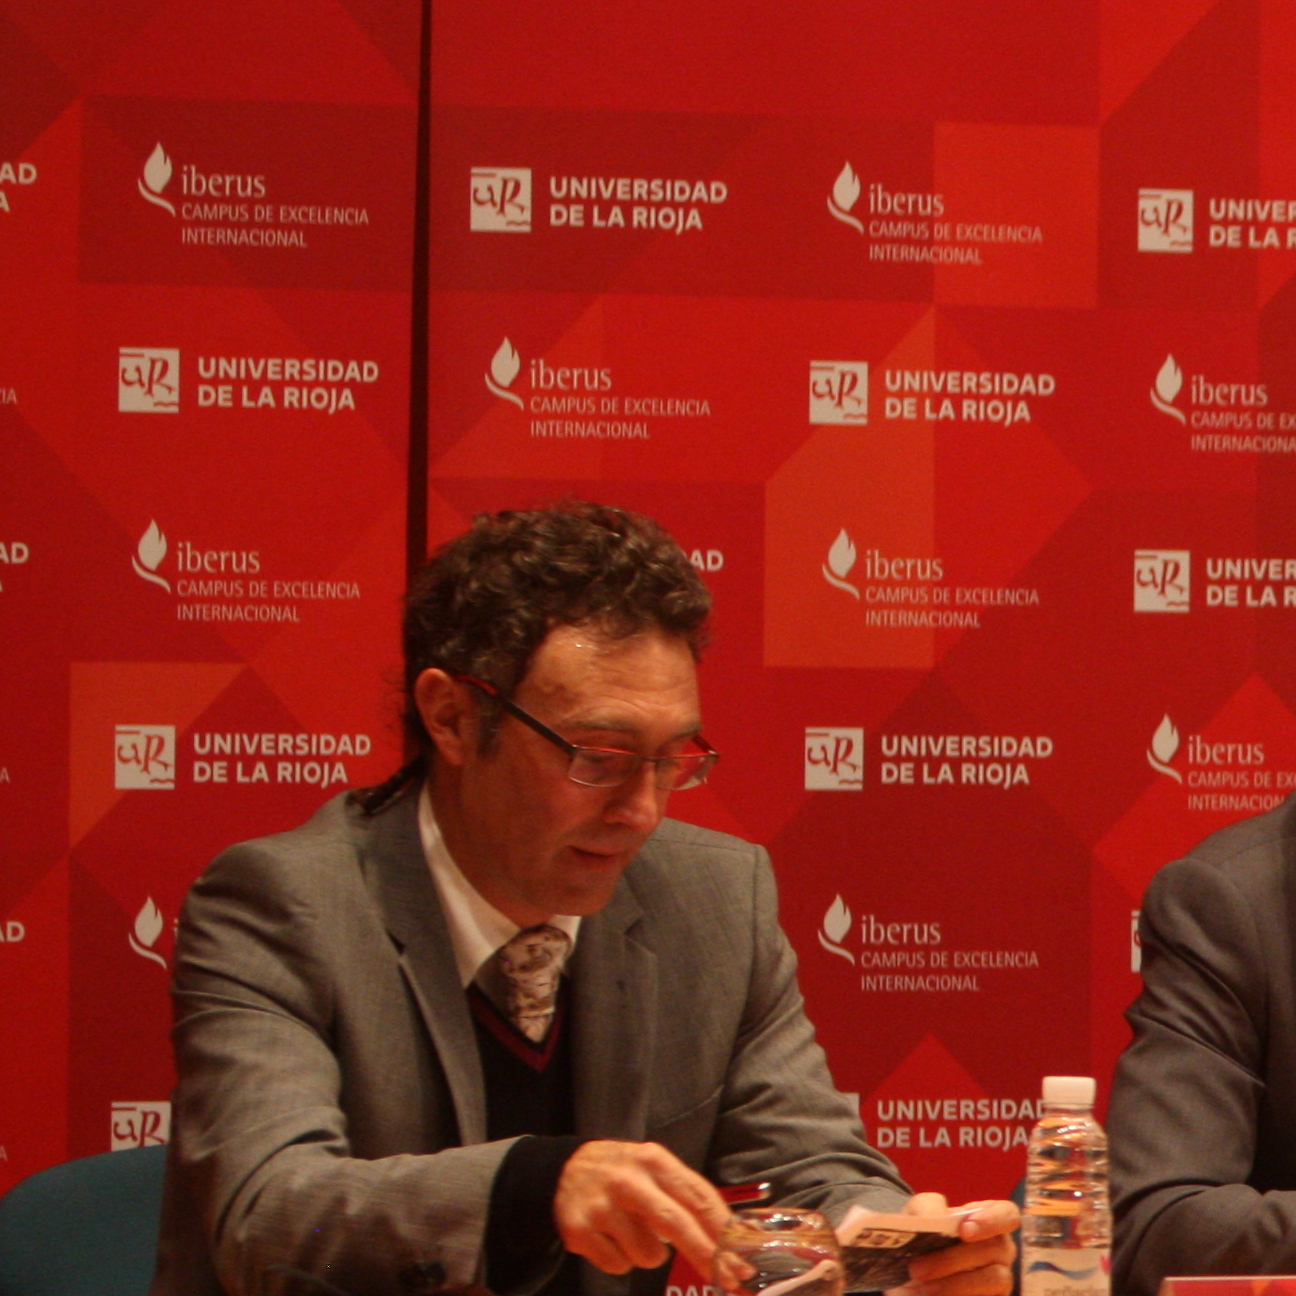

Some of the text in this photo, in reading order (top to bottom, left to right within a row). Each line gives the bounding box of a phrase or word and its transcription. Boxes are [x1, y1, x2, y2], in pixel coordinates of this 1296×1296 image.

[182, 165, 266, 197] iberus
[550, 177, 727, 203] UNIVERSIDAD
[869, 184, 944, 216] iberus
[182, 204, 369, 225] CAMPUS DE EXCELENCIA
[550, 204, 702, 234] DE LA RIOJA
[182, 227, 307, 247] INTERNACIONAL
[869, 221, 1042, 242] CAMPUS DE EXCELENCIA
[1209, 225, 1241, 247] DE
[1249, 227, 1280, 248] LA
[869, 244, 982, 265] INTERNACIONAL
[198, 357, 379, 383] UNIVERSIDAD
[530, 359, 612, 390] iberus
[885, 370, 1055, 395] UNIVERSIDAD
[1191, 375, 1268, 406] iberus
[198, 385, 355, 414] DE LA RIOJA
[530, 396, 710, 416] CAMPUS DE EXCELENCIA
[885, 397, 1030, 426] DE LA RIOJA
[1191, 412, 1252, 429] CAMPUS
[1257, 414, 1274, 429] DE
[531, 420, 649, 438] INTERNACIONAL
[177, 542, 260, 573] iberus
[866, 549, 943, 580] iberus
[177, 580, 360, 599] CAMPUS DE EXCELENCIA
[865, 587, 1039, 605] CAMPUS DE EXCELENCIA
[1206, 585, 1238, 606] DE
[1246, 586, 1277, 607] LA
[177, 604, 300, 622] INTERNACIONAL
[865, 609, 980, 628] INTERNACIONAL
[194, 733, 371, 755] UNIVERSIDAD
[882, 736, 1053, 757] UNIVERSIDAD
[1188, 735, 1264, 765] iberus
[193, 761, 348, 788] DE LA RIOJA
[881, 763, 1029, 789] DE LA RIOJA
[1188, 771, 1248, 788] CAMPUS
[1254, 771, 1271, 788] DE
[1188, 793, 1284, 811] INTERNACION
[861, 915, 941, 944] iberus
[861, 952, 1039, 968] CAMPUS DE EXCELENCIA
[861, 975, 979, 991] INTERNACIONAL
[877, 1126, 1028, 1152] DE LA RIOJA
